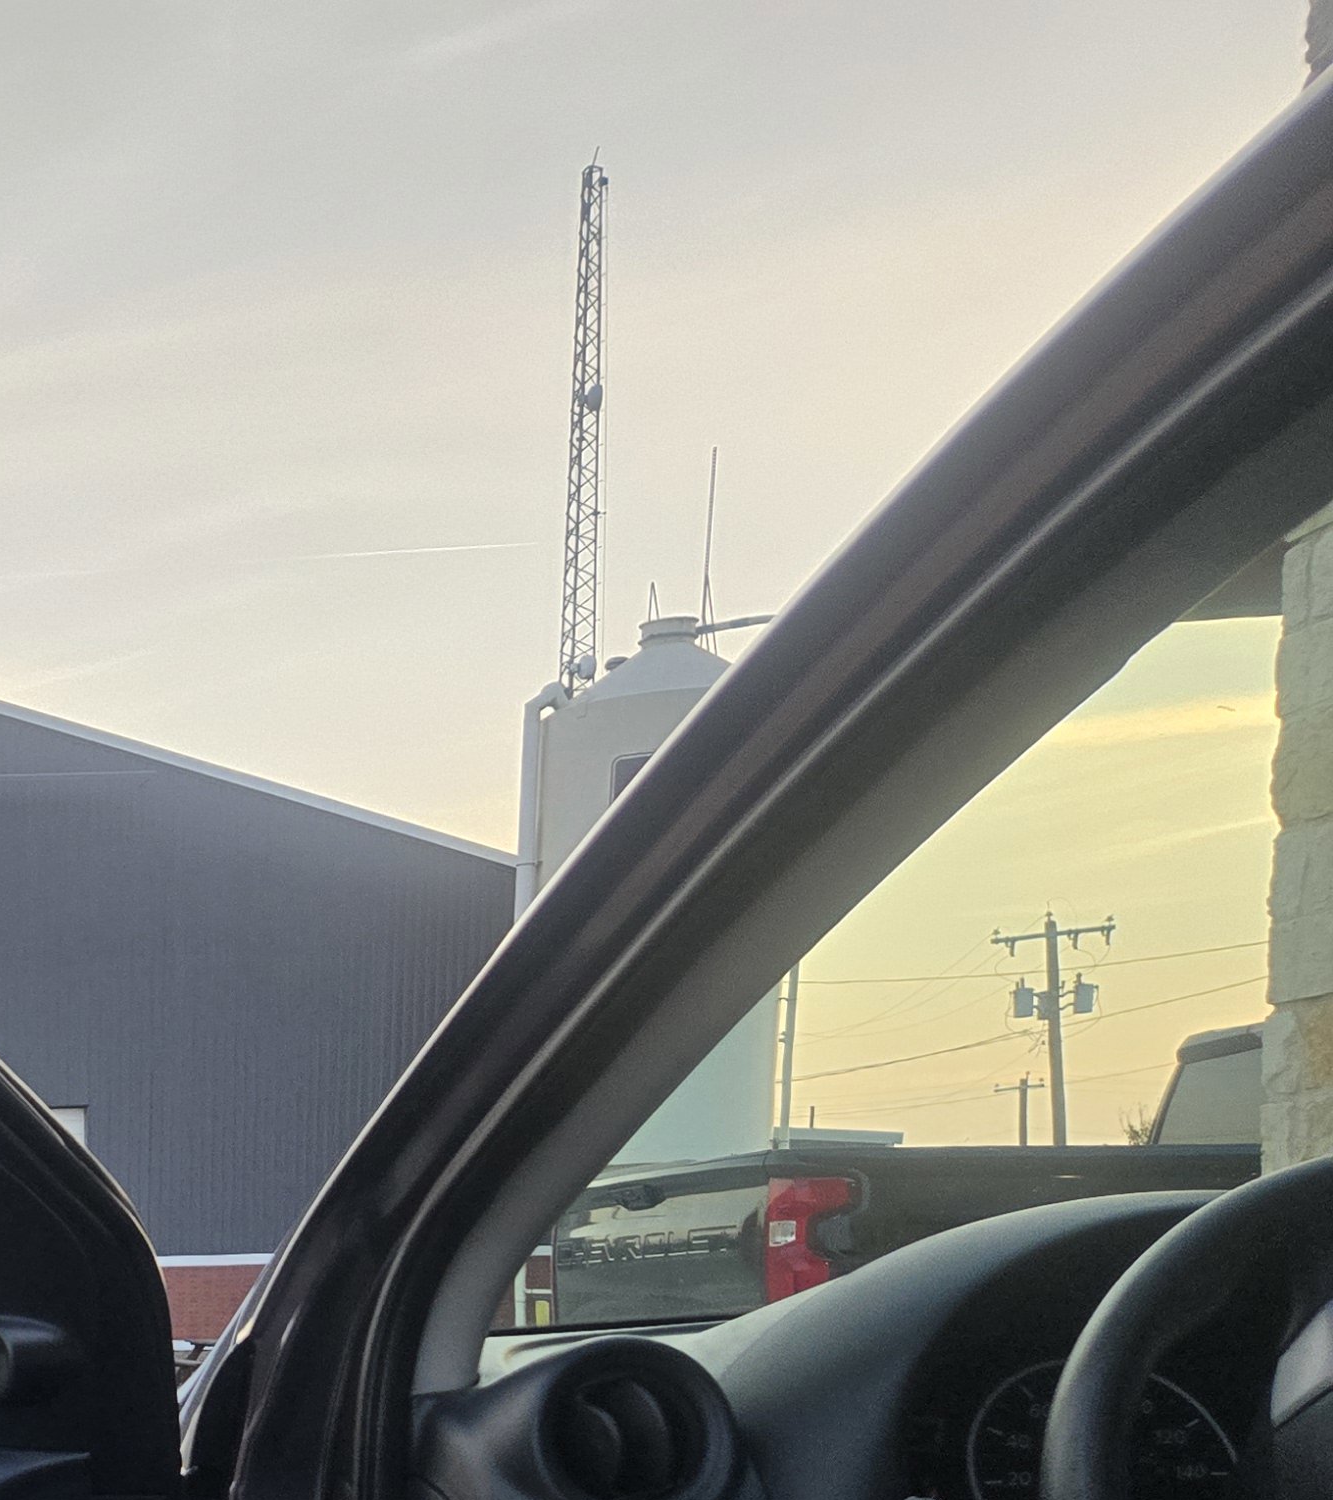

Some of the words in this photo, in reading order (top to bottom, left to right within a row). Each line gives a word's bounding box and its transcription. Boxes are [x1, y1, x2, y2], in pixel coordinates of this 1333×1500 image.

[1004, 1433, 1030, 1449] 40
[1007, 1471, 1032, 1486] 20
[1176, 1464, 1207, 1481] 140
